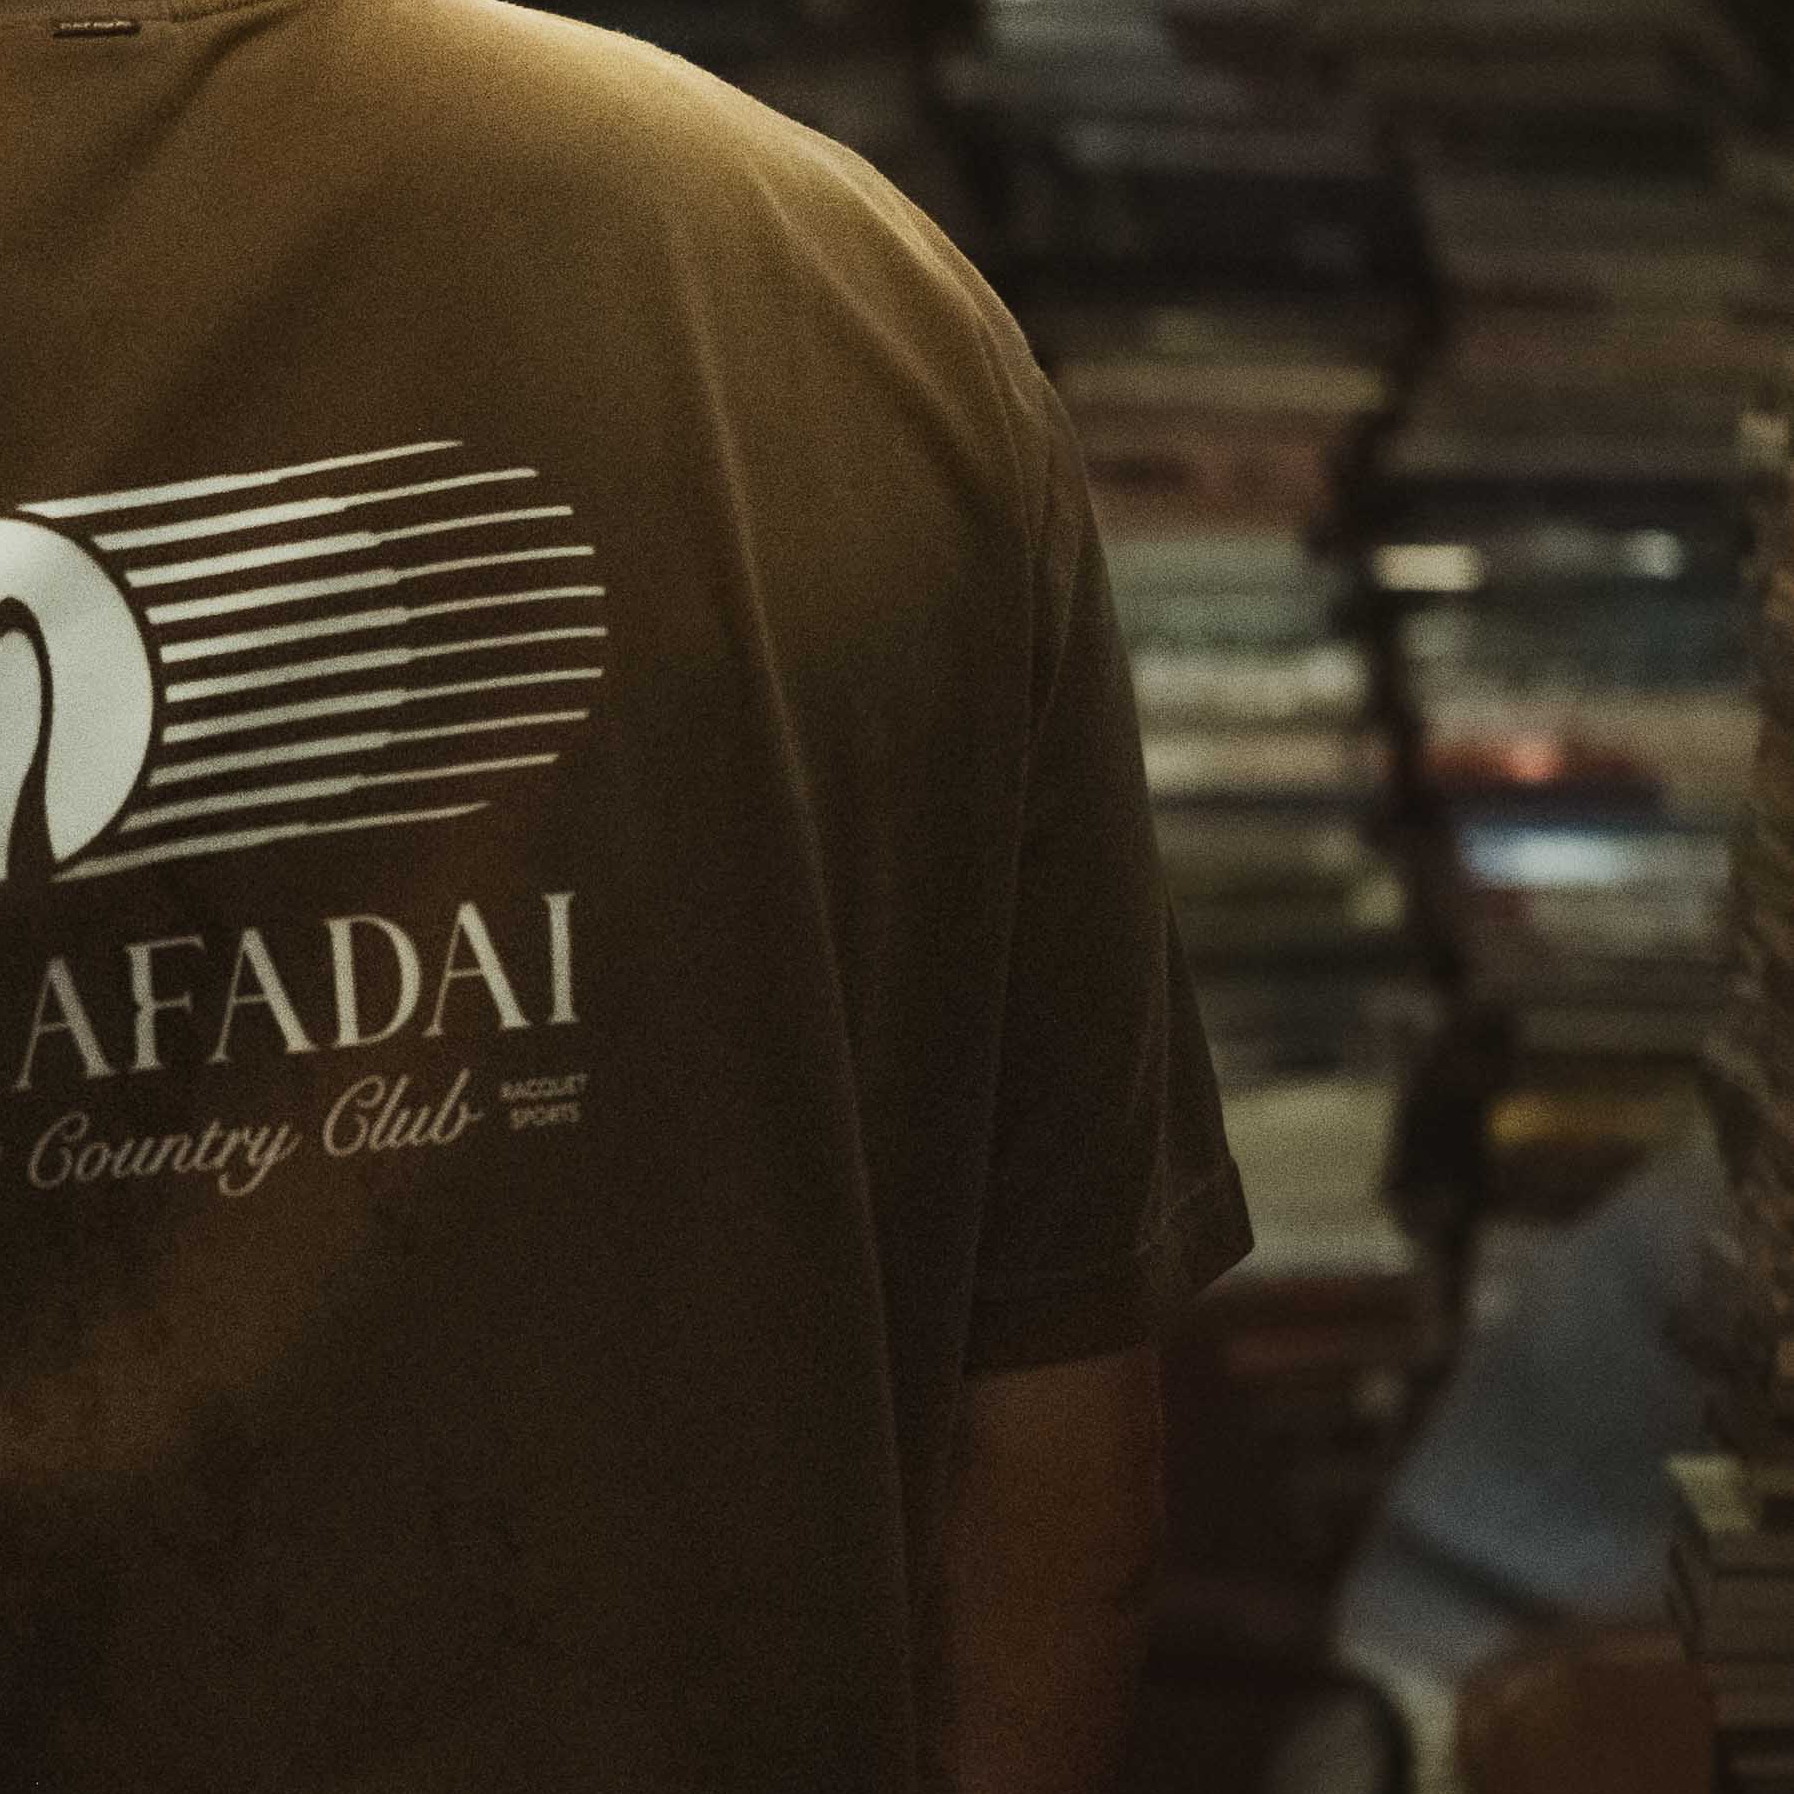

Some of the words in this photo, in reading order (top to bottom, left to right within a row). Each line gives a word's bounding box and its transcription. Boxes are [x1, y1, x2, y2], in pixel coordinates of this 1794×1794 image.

[26, 1110, 302, 1198] Country
[321, 1068, 483, 1158] Club
[508, 1102, 583, 1132] SPORTS
